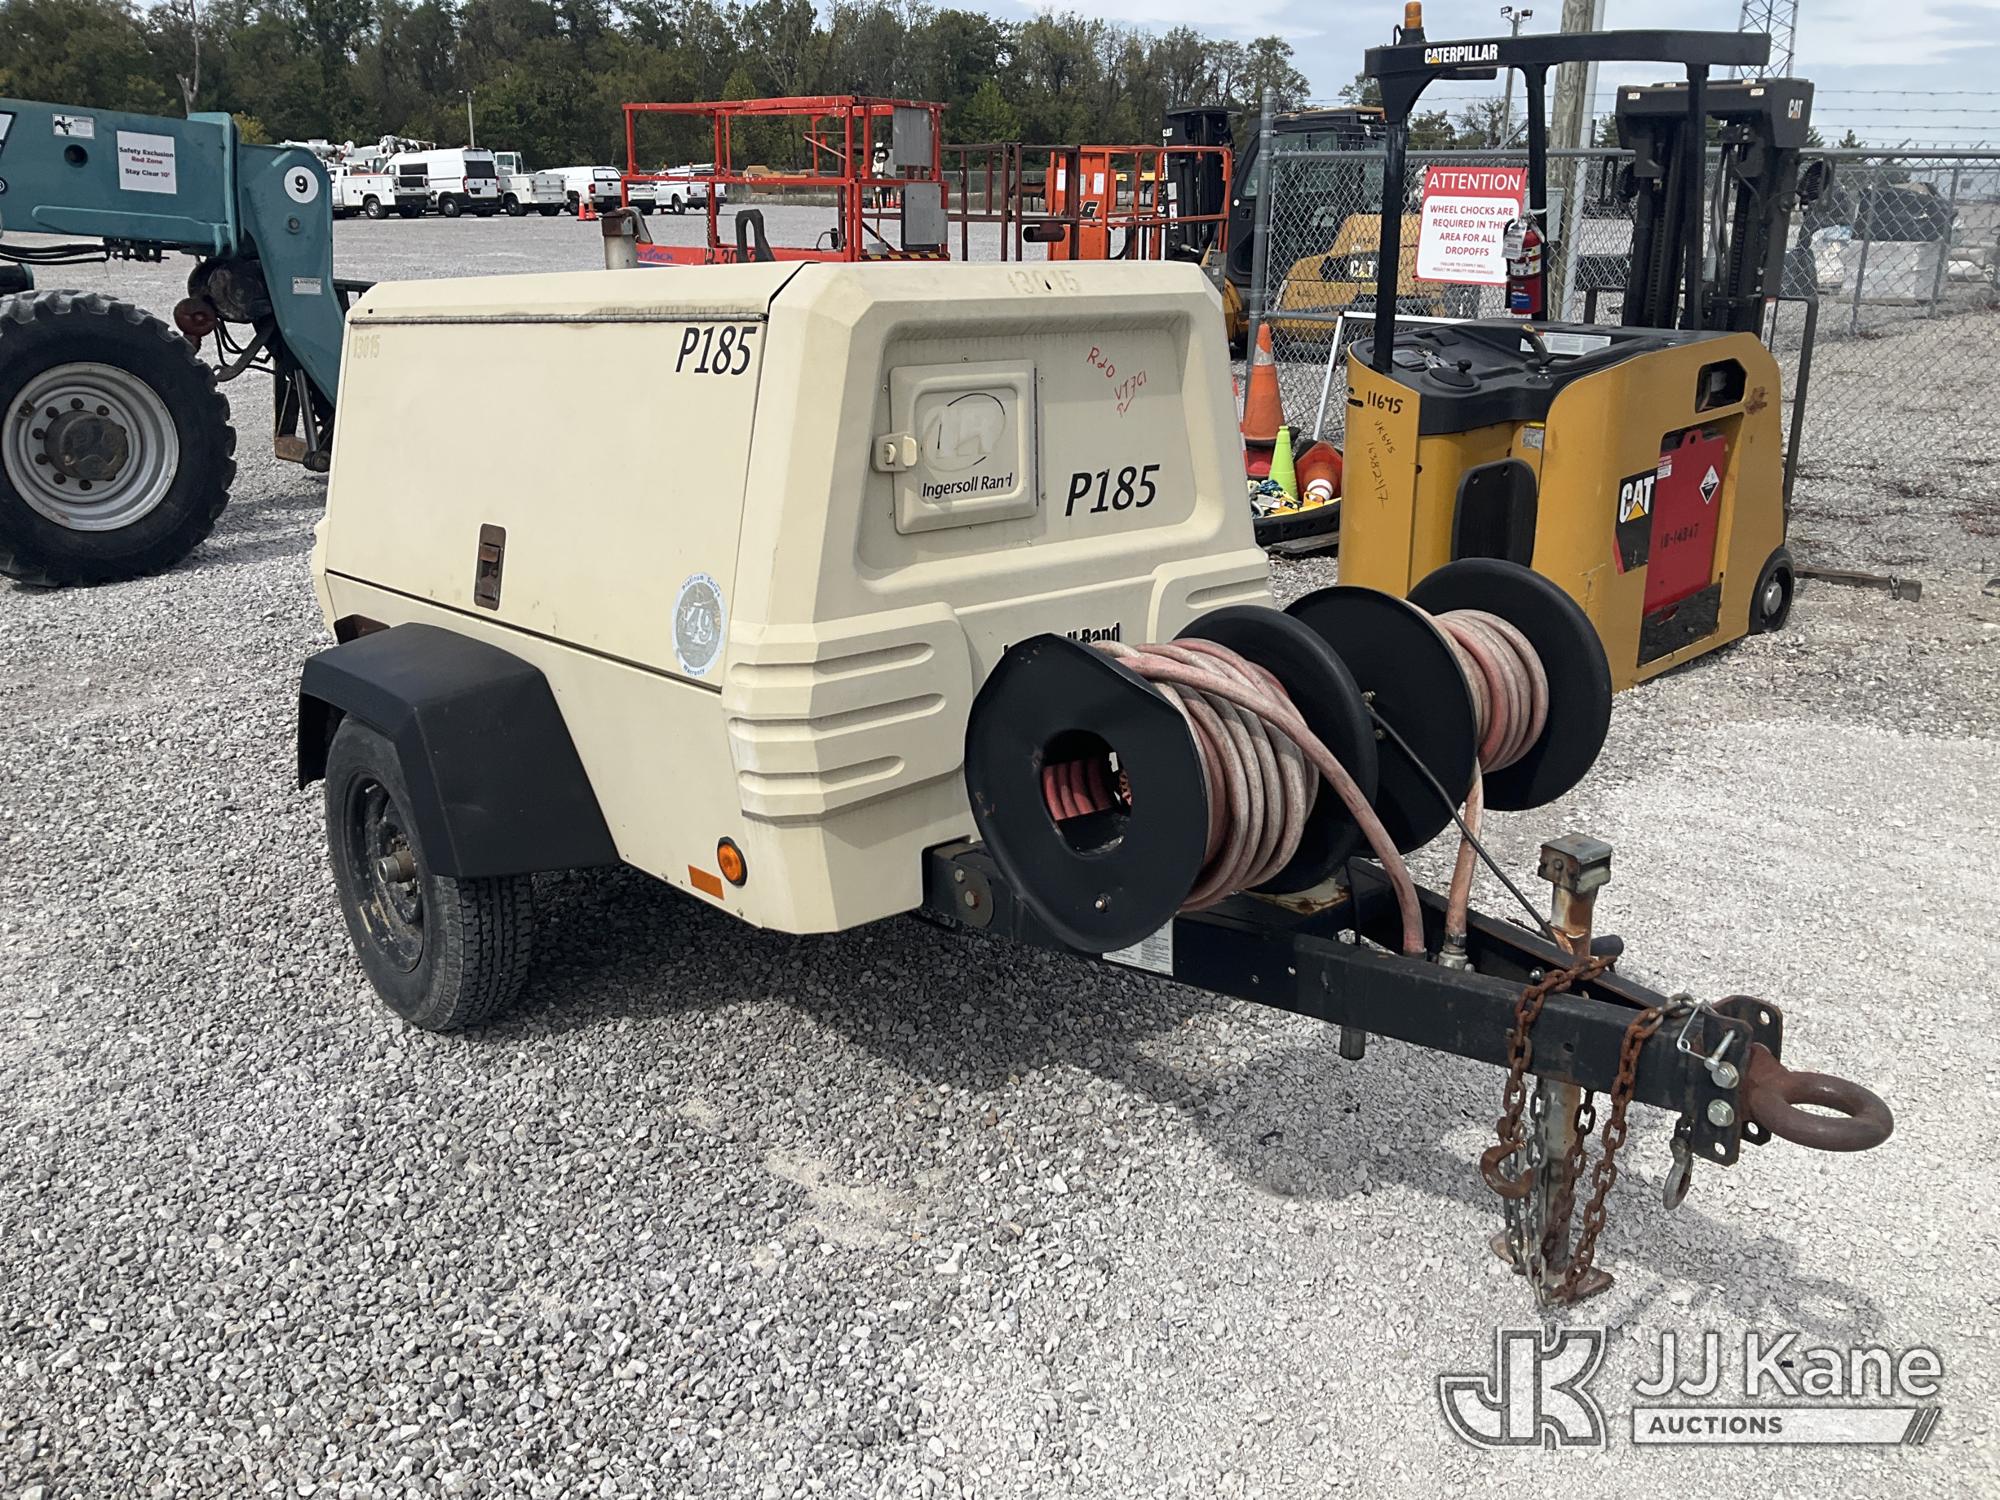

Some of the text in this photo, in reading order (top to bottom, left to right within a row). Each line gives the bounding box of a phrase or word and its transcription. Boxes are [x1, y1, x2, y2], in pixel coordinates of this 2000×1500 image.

[1424, 44, 1498, 64] CATERPILLAR
[1788, 99, 1803, 119] CAT
[1162, 128, 1173, 137] CAT
[119, 147, 174, 158] Safety Exclusion
[146, 157, 163, 165] Zone
[125, 168, 140, 176] Stay
[142, 169, 159, 177] Clear
[294, 175, 308, 194] 9
[1428, 173, 1521, 191] ATTENTION
[1430, 205, 1514, 216] WHEEL CHOCKS ARE
[1432, 219, 1474, 229] REQUIRED
[1476, 220, 1486, 229] IN
[1439, 232, 1496, 243] AREA FOR ALL
[1445, 246, 1489, 256] DROPOFFS
[1349, 260, 1377, 278] CAT
[675, 325, 757, 375] P185
[1367, 390, 1404, 414] 11645
[922, 472, 1013, 499] Ingersoll Rand
[1065, 464, 1160, 517] P185
[1619, 475, 1655, 523] CAT
[682, 575, 721, 597] Platinum Series
[683, 665, 705, 676] Warranty
